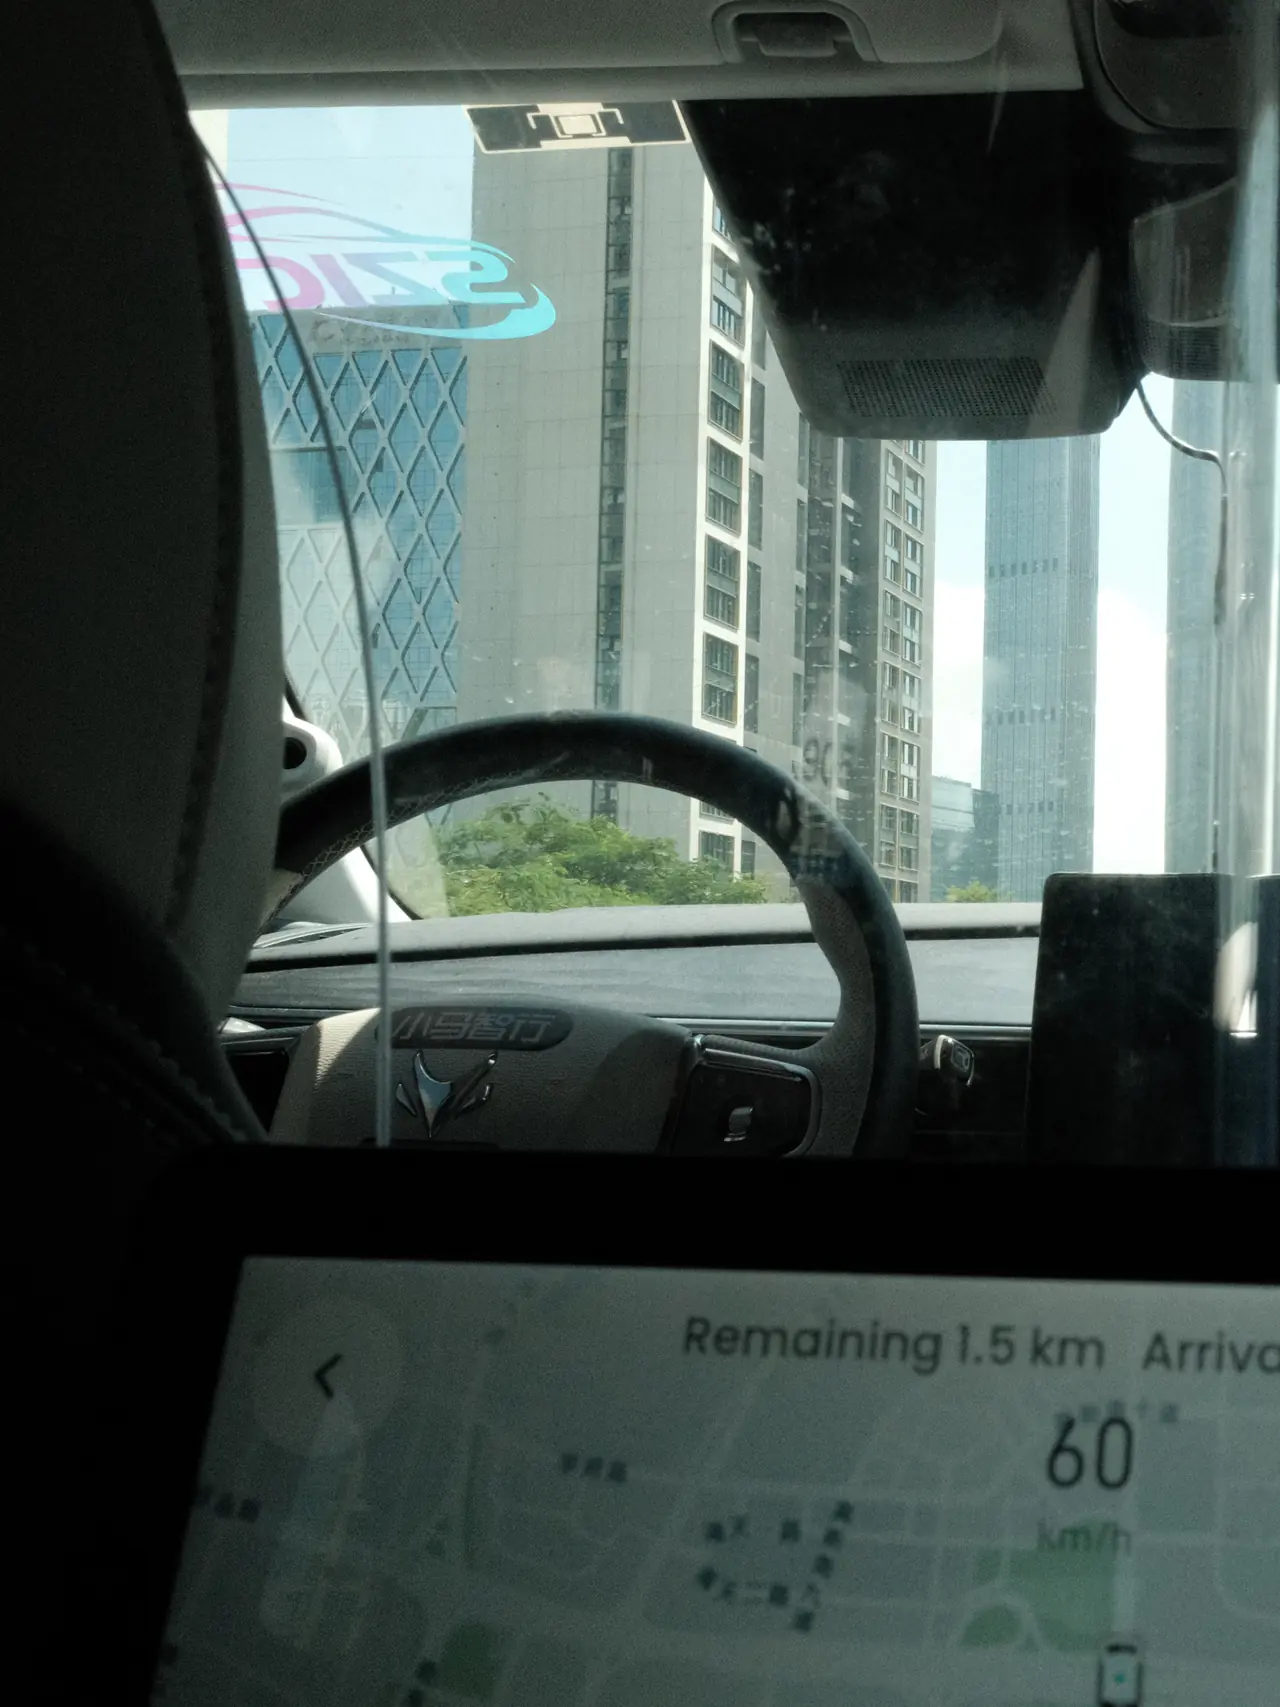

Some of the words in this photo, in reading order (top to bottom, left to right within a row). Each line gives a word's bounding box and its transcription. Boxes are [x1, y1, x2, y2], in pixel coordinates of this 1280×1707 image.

[684, 1317, 942, 1375] Remaining
[959, 1325, 1016, 1365] 1.5
[1031, 1327, 1106, 1369] km
[1046, 1416, 1134, 1489] 60
[1038, 1520, 1132, 1555] km/h
